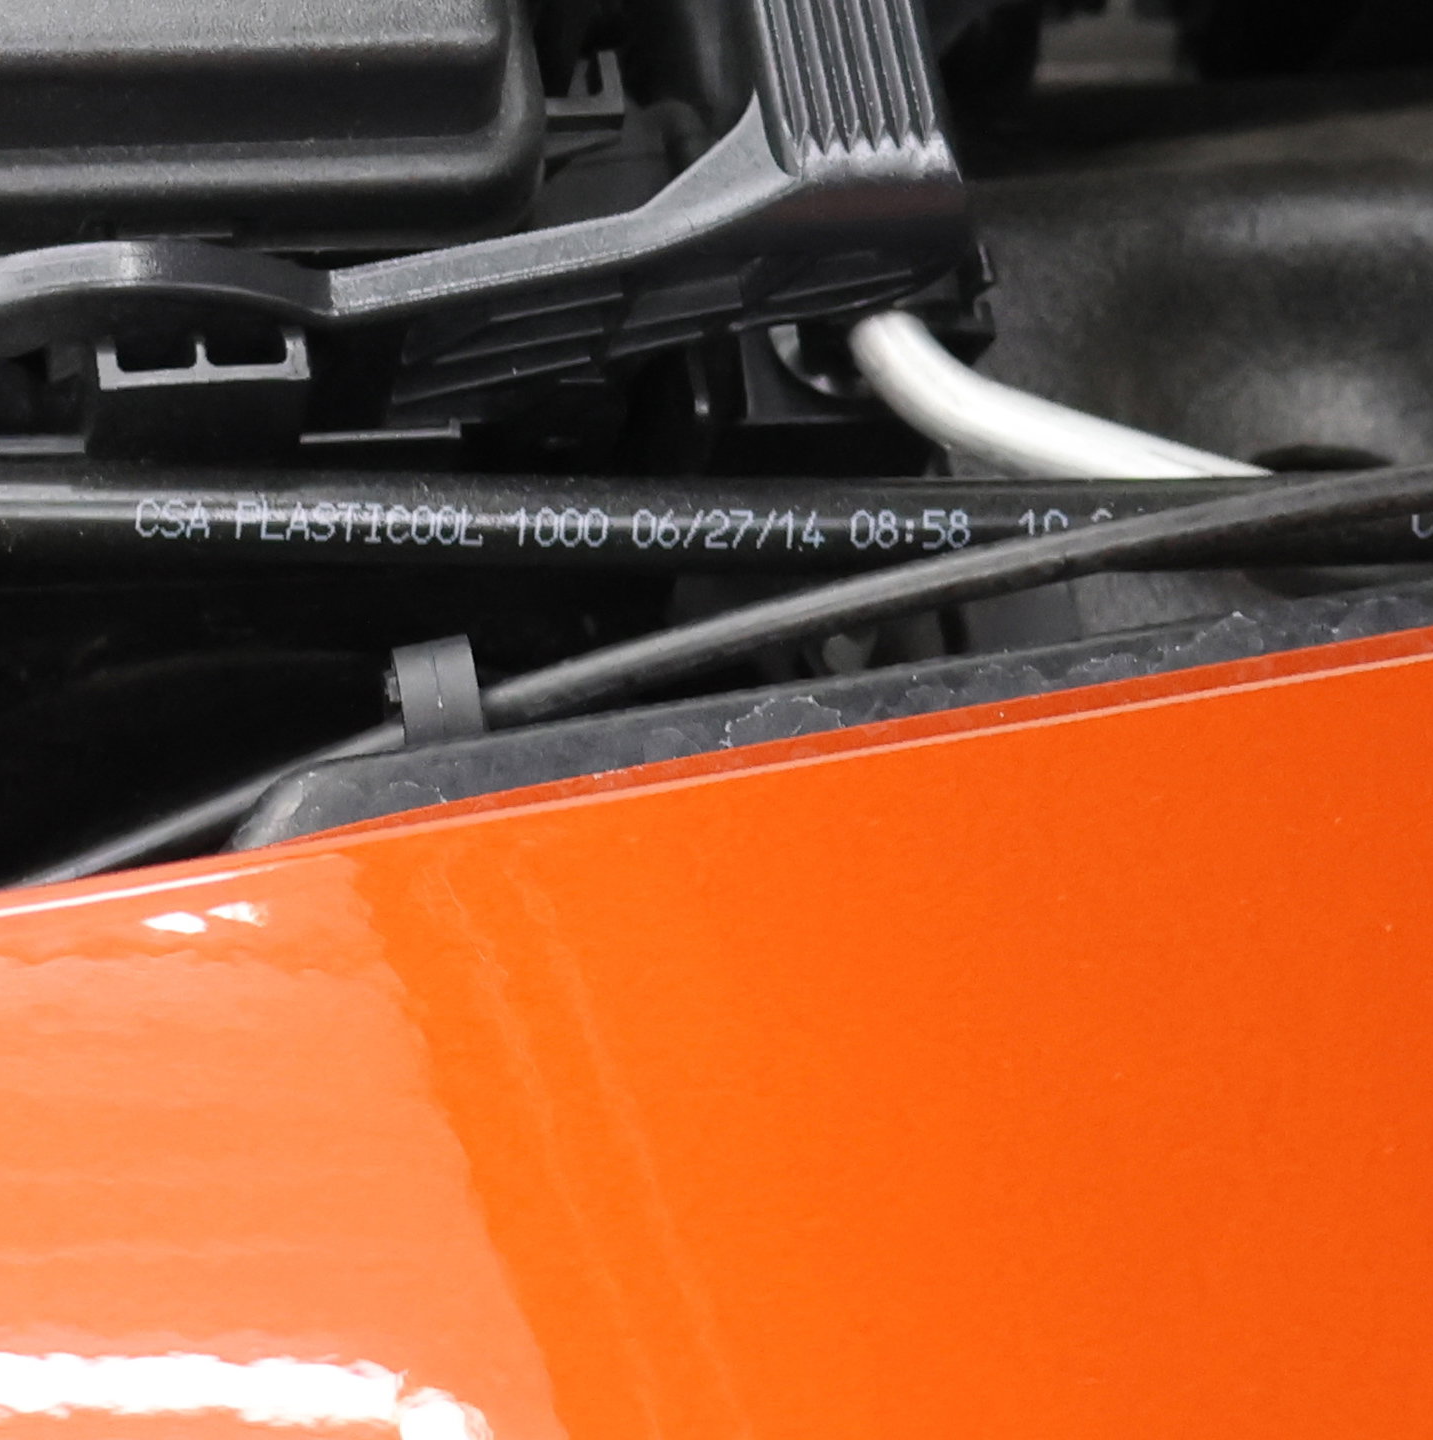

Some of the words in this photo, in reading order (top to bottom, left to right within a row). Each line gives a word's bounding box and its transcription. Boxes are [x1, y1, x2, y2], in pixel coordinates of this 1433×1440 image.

[135, 497, 211, 540] CSA
[233, 497, 483, 547] PLASTICOOL
[510, 506, 609, 548] 1000
[632, 507, 825, 550] 06/27/14
[850, 508, 972, 550] 08:58
